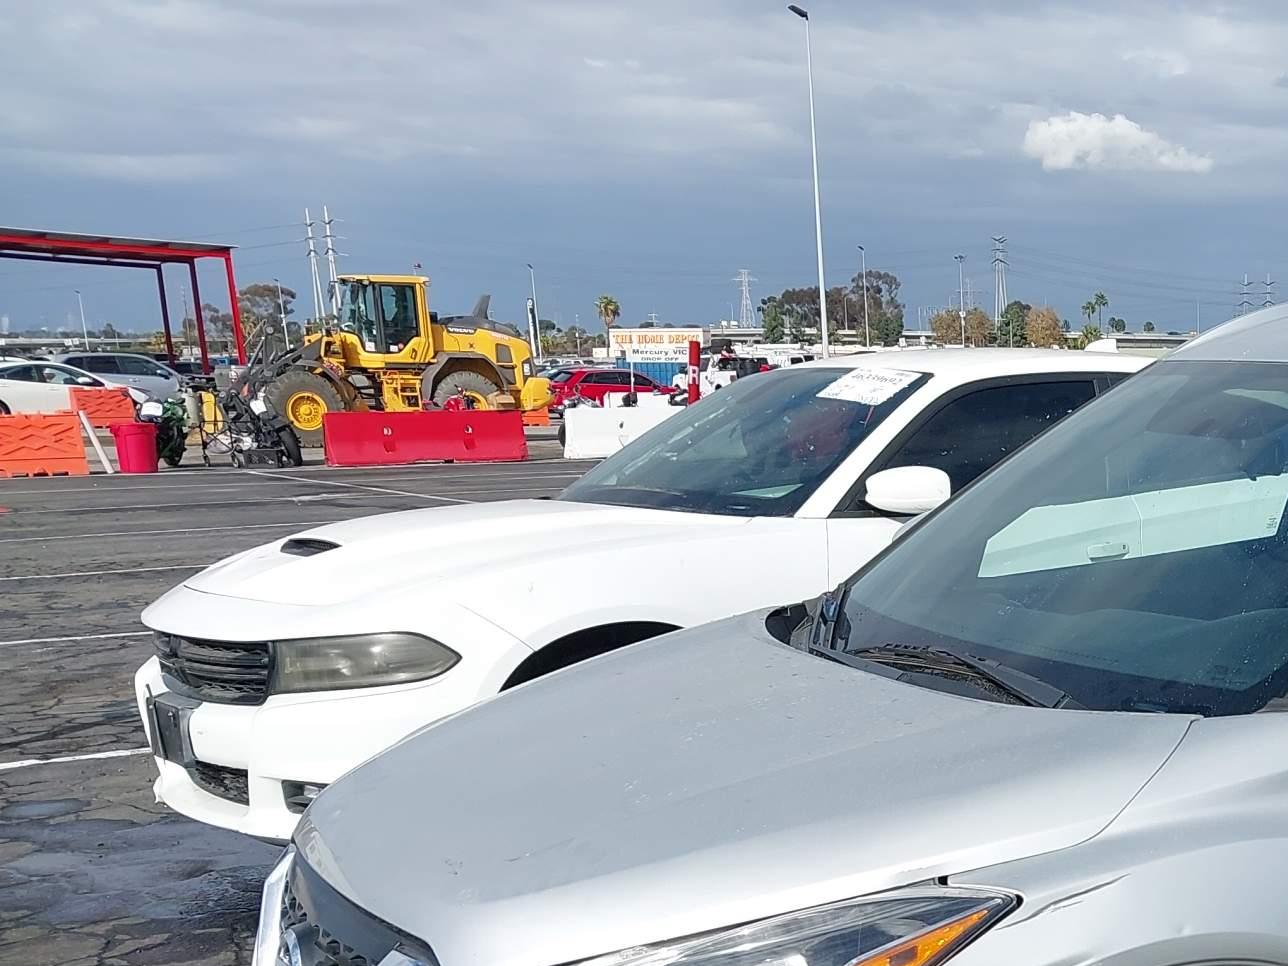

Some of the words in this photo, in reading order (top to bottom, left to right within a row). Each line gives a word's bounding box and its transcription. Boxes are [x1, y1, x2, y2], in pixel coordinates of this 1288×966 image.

[613, 334, 633, 344] THE
[637, 334, 665, 344] HOME
[632, 348, 669, 356] Mercury
